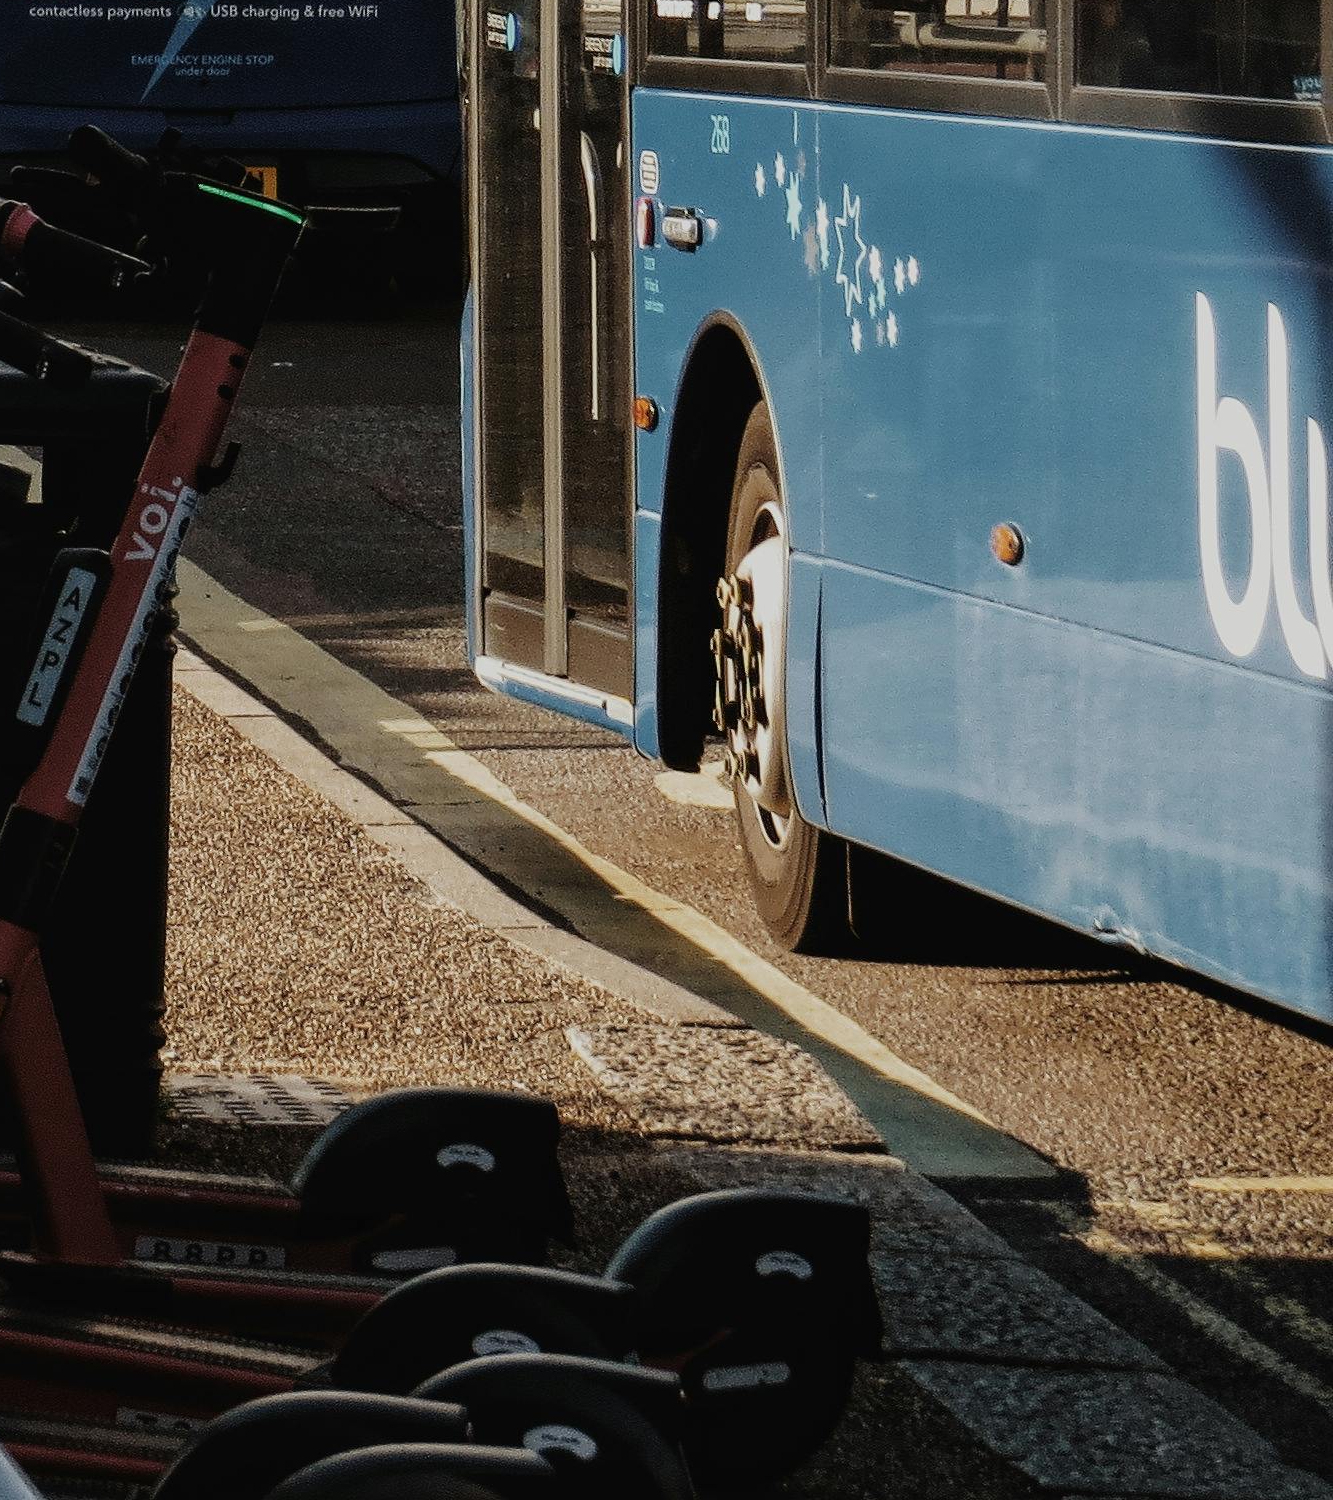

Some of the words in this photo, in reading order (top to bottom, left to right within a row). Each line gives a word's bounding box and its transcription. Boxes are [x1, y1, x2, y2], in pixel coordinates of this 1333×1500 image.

[29, 5, 104, 18] contactless
[107, 5, 172, 21] payments
[211, 4, 238, 18] USB
[242, 4, 300, 21] charging
[303, 4, 315, 18] &
[318, 4, 345, 18] free
[348, 4, 379, 18] WiFi
[130, 55, 199, 66] EMERGENCY
[201, 55, 244, 66] ENGINE
[245, 55, 275, 66] STOP
[175, 66, 205, 77] under
[124, 475, 183, 564] voi.
[26, 586, 81, 708] AZPL
